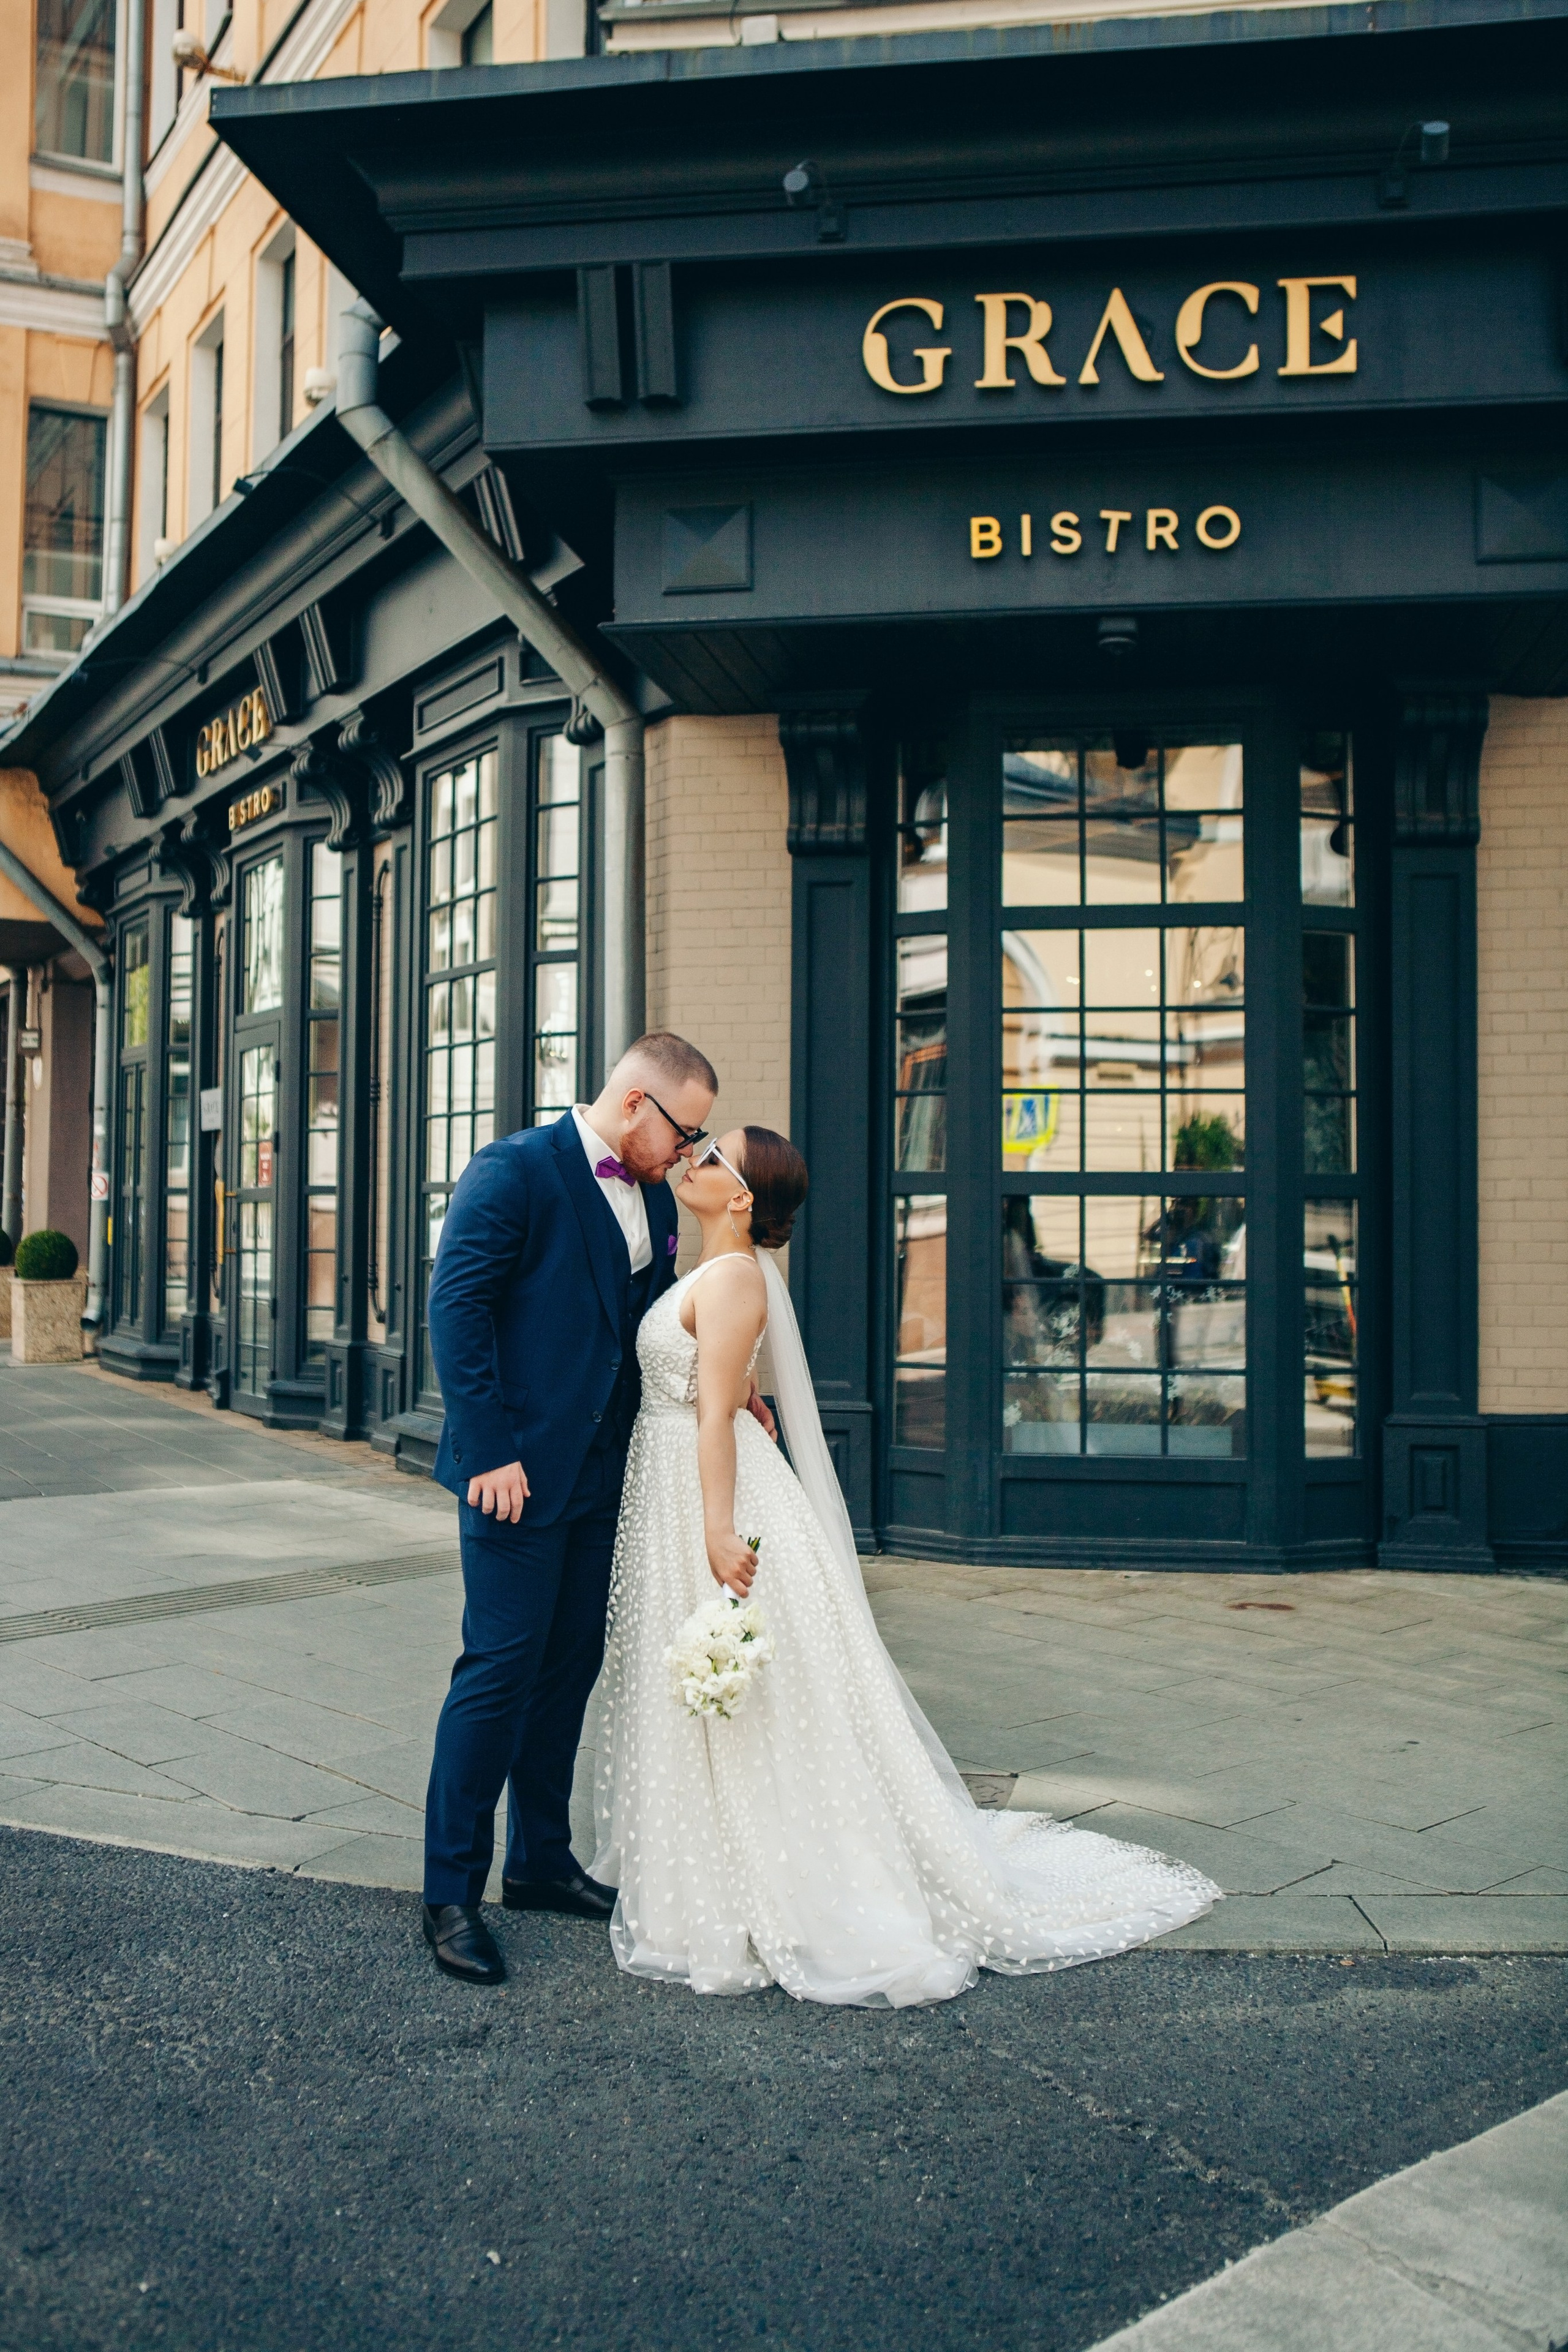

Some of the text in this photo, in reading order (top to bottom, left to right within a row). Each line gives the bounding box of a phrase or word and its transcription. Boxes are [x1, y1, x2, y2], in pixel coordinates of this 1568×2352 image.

[862, 275, 1357, 394] GRACE
[970, 505, 1241, 558] BISTRO
[228, 785, 272, 831] BSTRO
